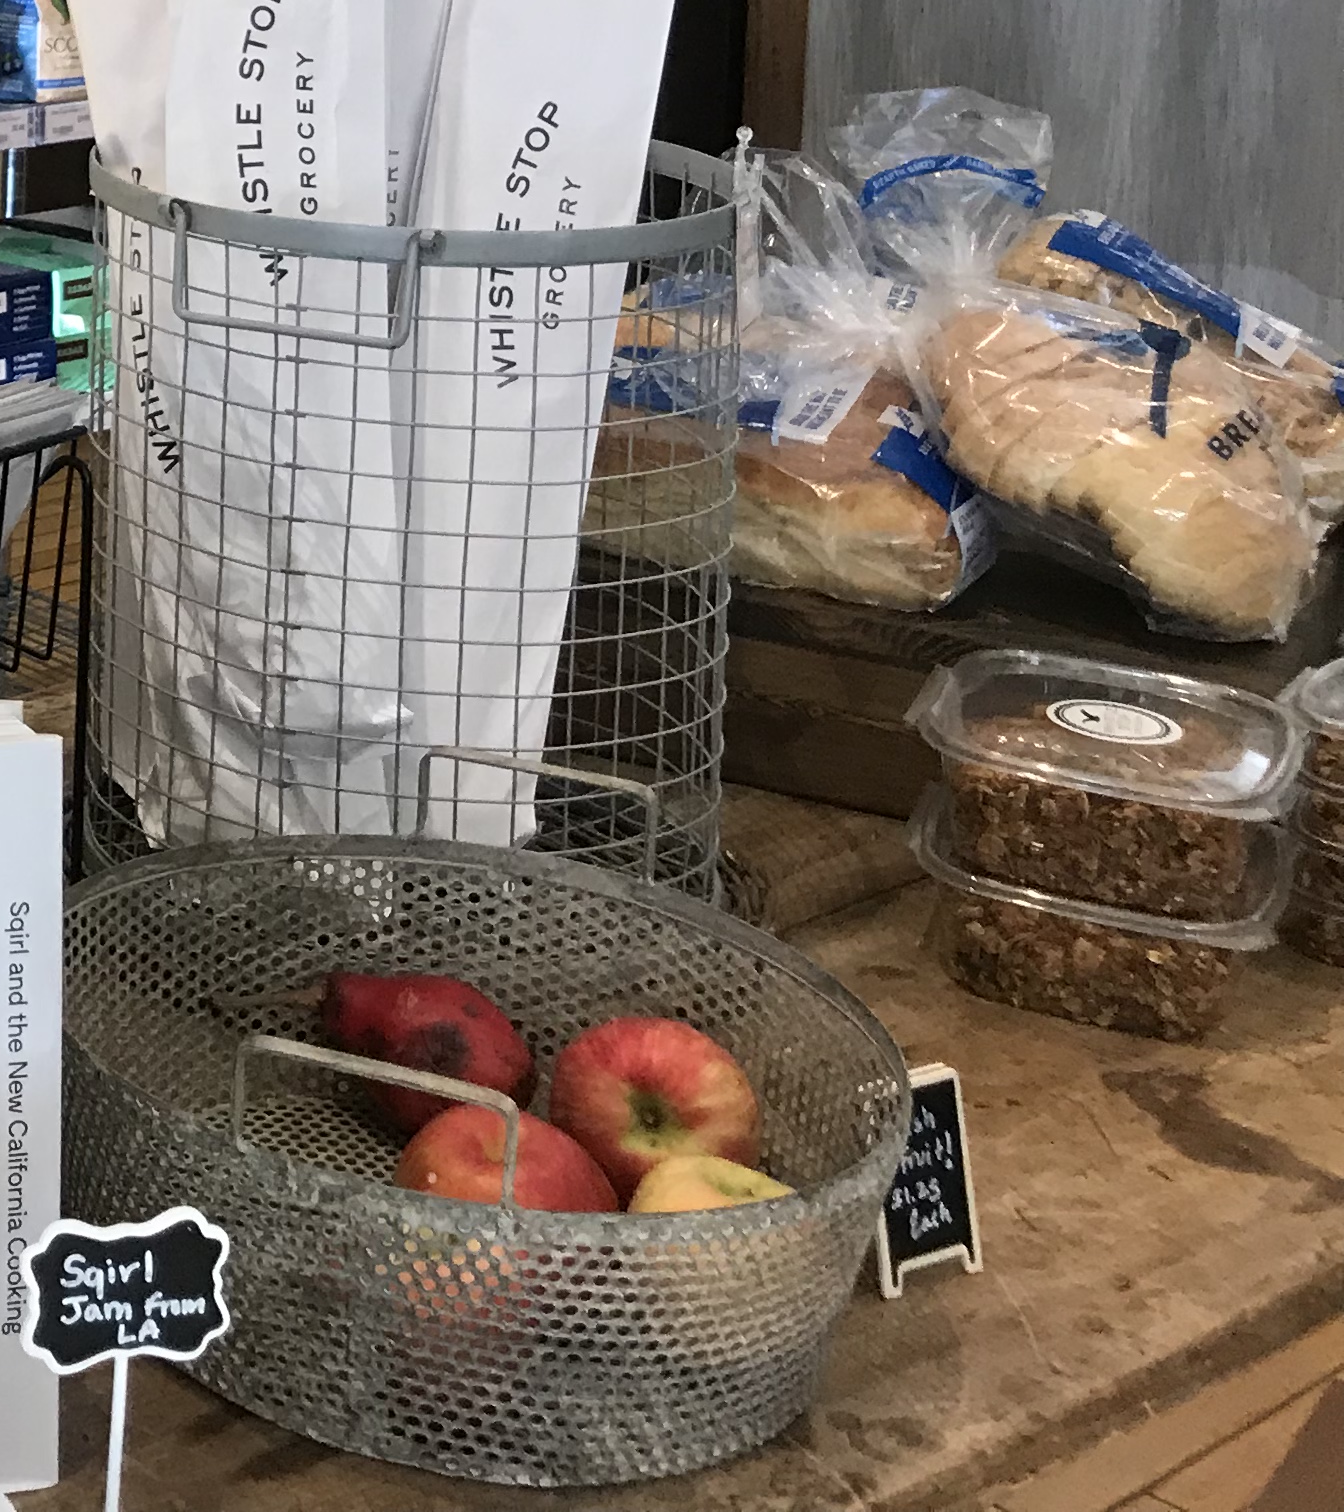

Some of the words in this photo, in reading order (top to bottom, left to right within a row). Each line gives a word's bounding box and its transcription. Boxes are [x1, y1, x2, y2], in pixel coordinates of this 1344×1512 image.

[294, 50, 318, 217] GROCERY
[505, 99, 560, 198] STOP
[4, 901, 31, 956] Sqirl
[8, 961, 30, 1007] and
[7, 1010, 29, 1053] the
[7, 1061, 29, 1114] New
[6, 1119, 29, 1233] California
[1, 1235, 28, 1337] Cooking
[59, 1252, 156, 1299] Sqirl
[59, 1292, 134, 1326] Jam
[141, 1291, 207, 1321] from
[116, 1319, 162, 1345] LA
